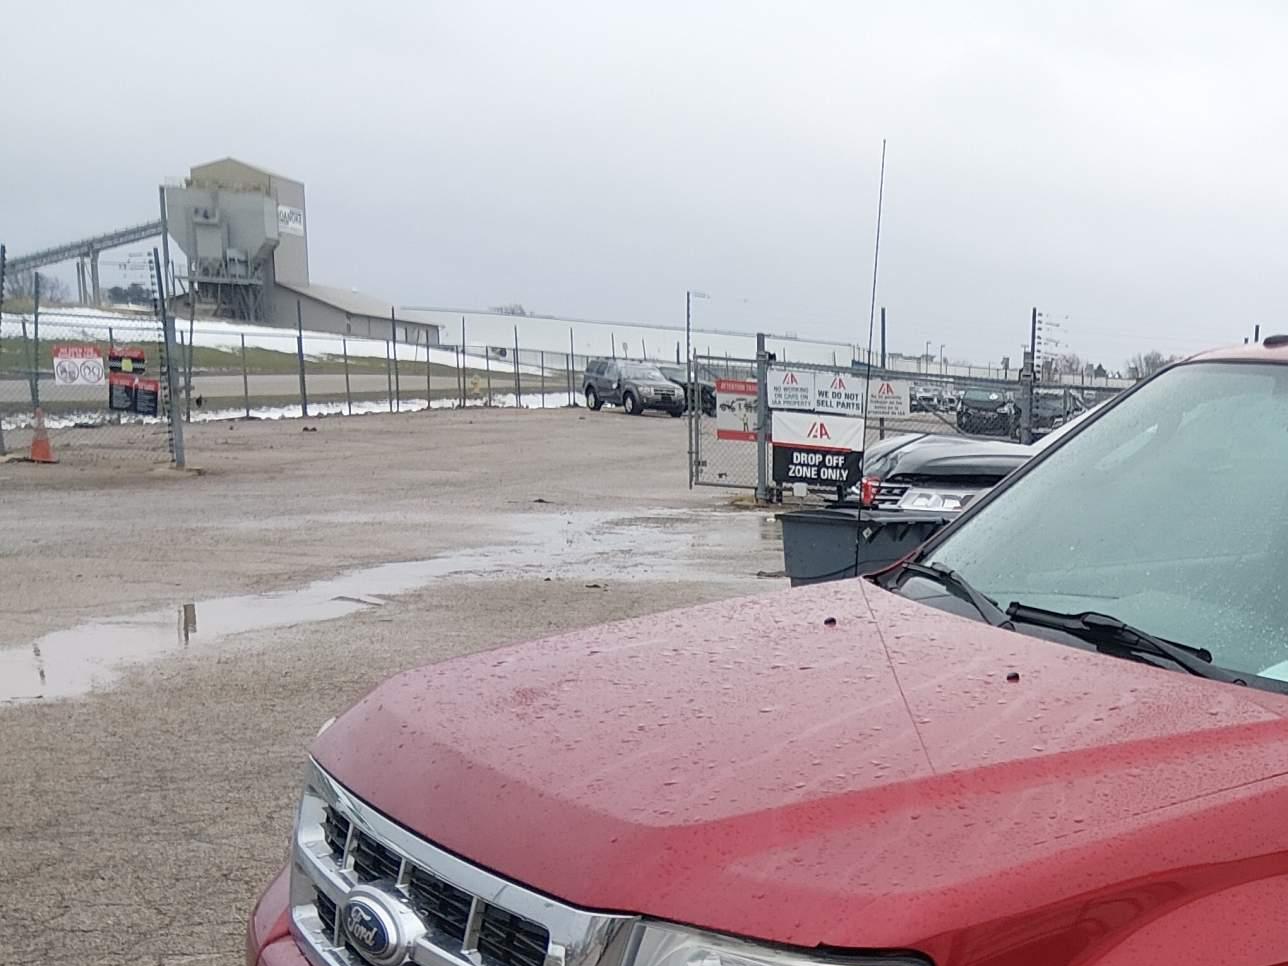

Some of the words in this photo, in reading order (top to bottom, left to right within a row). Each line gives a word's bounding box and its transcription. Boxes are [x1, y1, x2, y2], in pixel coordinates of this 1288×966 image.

[818, 390, 829, 399] WE
[832, 391, 843, 400] DO
[844, 392, 860, 401] NOT
[816, 400, 834, 409] SELL
[836, 401, 861, 411] PARTS
[793, 451, 823, 466] DROP
[825, 455, 845, 468] OFF
[788, 464, 818, 479] ZONE
[820, 468, 849, 481] ONLY
[347, 906, 378, 946] Ford
